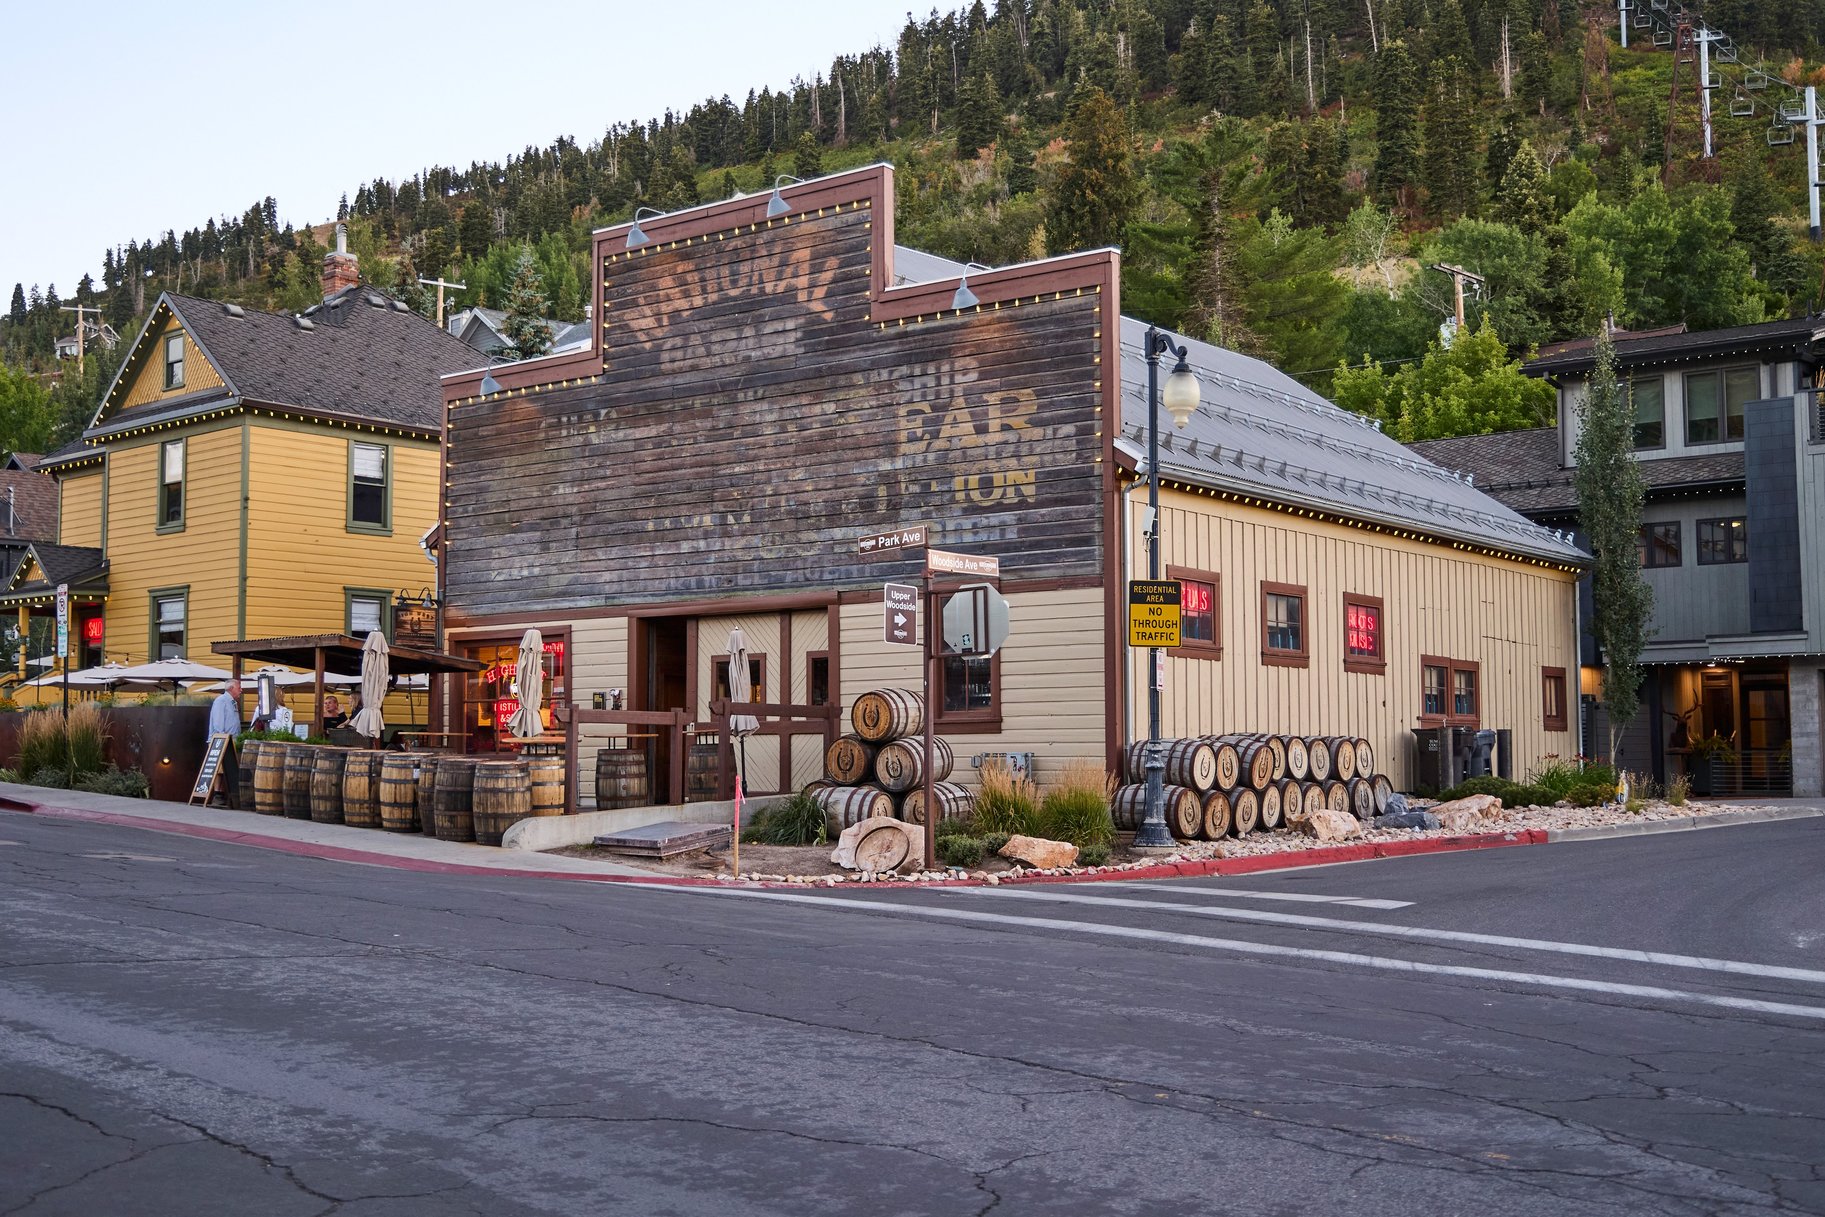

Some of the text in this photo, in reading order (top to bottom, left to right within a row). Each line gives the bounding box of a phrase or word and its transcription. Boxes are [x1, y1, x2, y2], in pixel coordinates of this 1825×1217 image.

[878, 534, 900, 548] Park
[901, 531, 921, 544] Ave
[931, 553, 964, 568] Woodside
[964, 559, 978, 570] Ave
[1133, 585, 1177, 594] RESIDENTIAL
[891, 590, 911, 601] Upper
[886, 600, 916, 612] Woodside
[1148, 607, 1163, 616] NO
[1132, 619, 1178, 629] THROUGH
[1135, 631, 1175, 641] TRAFFIC
